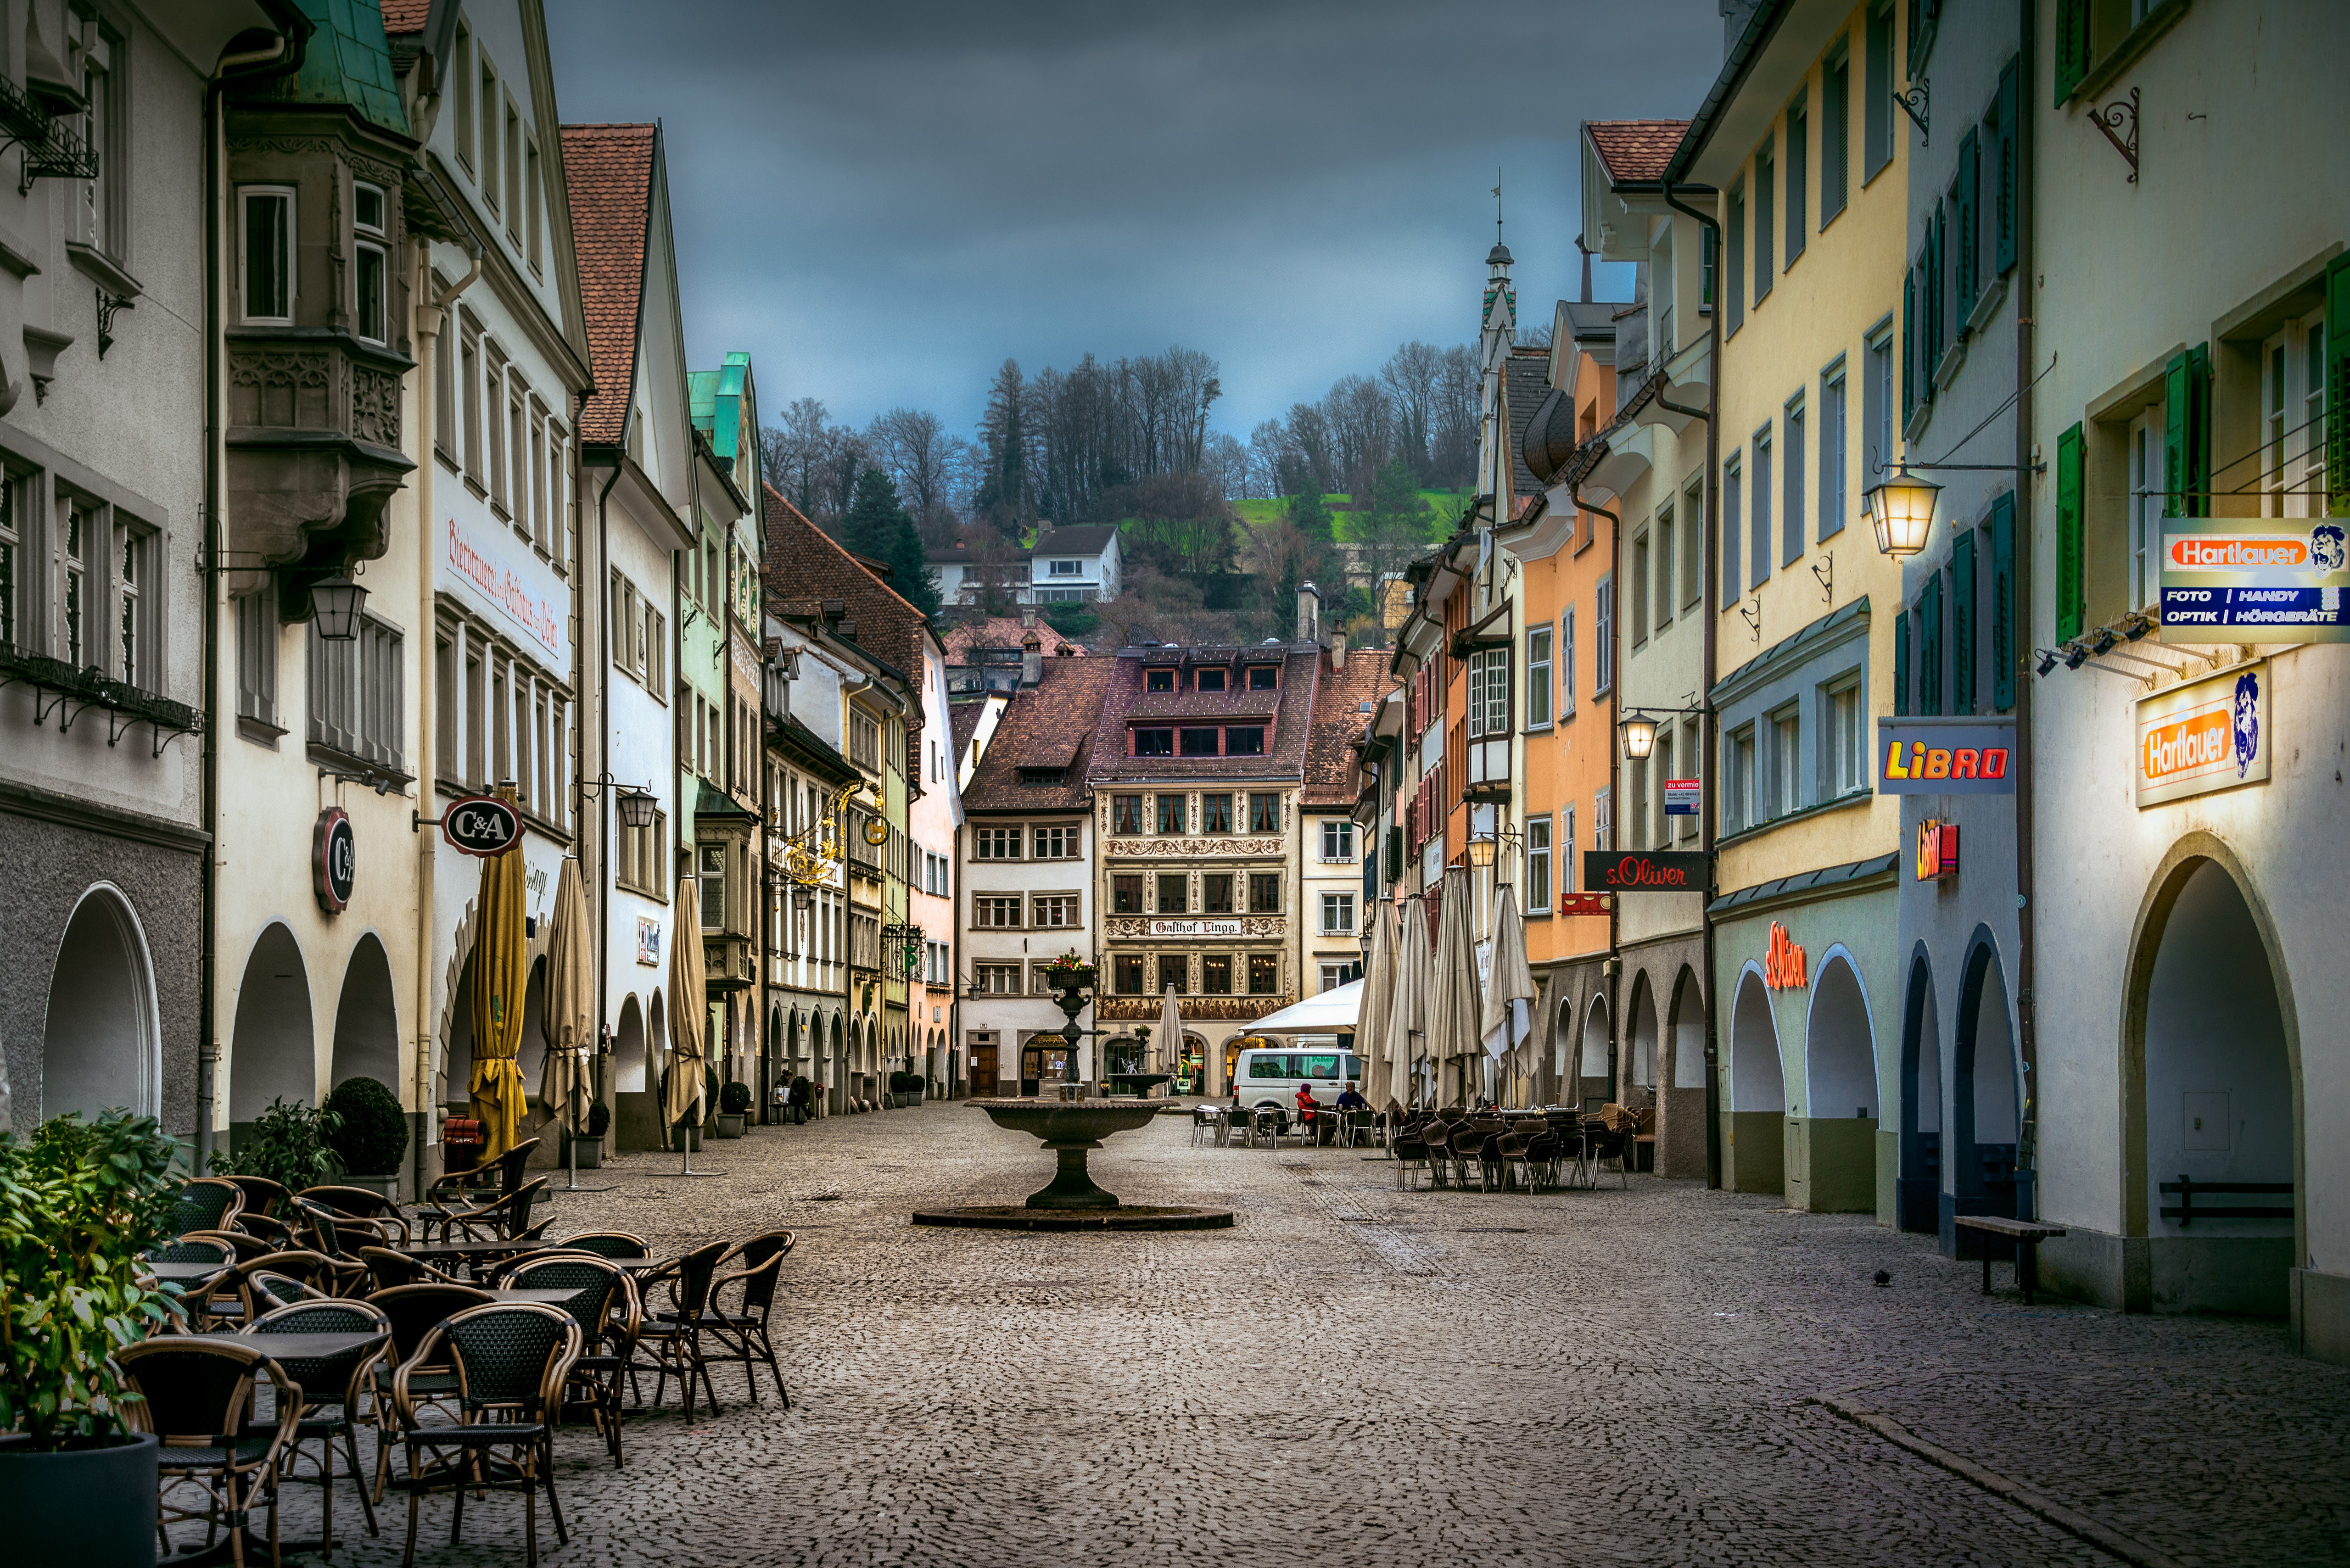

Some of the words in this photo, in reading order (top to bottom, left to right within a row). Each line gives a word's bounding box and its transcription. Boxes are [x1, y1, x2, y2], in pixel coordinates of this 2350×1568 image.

[2182, 541, 2298, 565] Hartlauer
[449, 516, 496, 598] Bierbrauerei
[505, 567, 532, 629] Gasthaus
[2166, 591, 2211, 602] FOTO
[2238, 591, 2299, 602] HANDY
[2166, 611, 2218, 622] OPTIK
[2235, 608, 2338, 622] HÖRGERÄTE
[2149, 725, 2225, 776] Hartlauer
[456, 811, 507, 841] C&A
[335, 837, 354, 883] C&A
[1606, 856, 1687, 886] s.Oliver
[1156, 921, 1197, 933] Gasthof
[1765, 921, 1808, 990] s.Oliver
